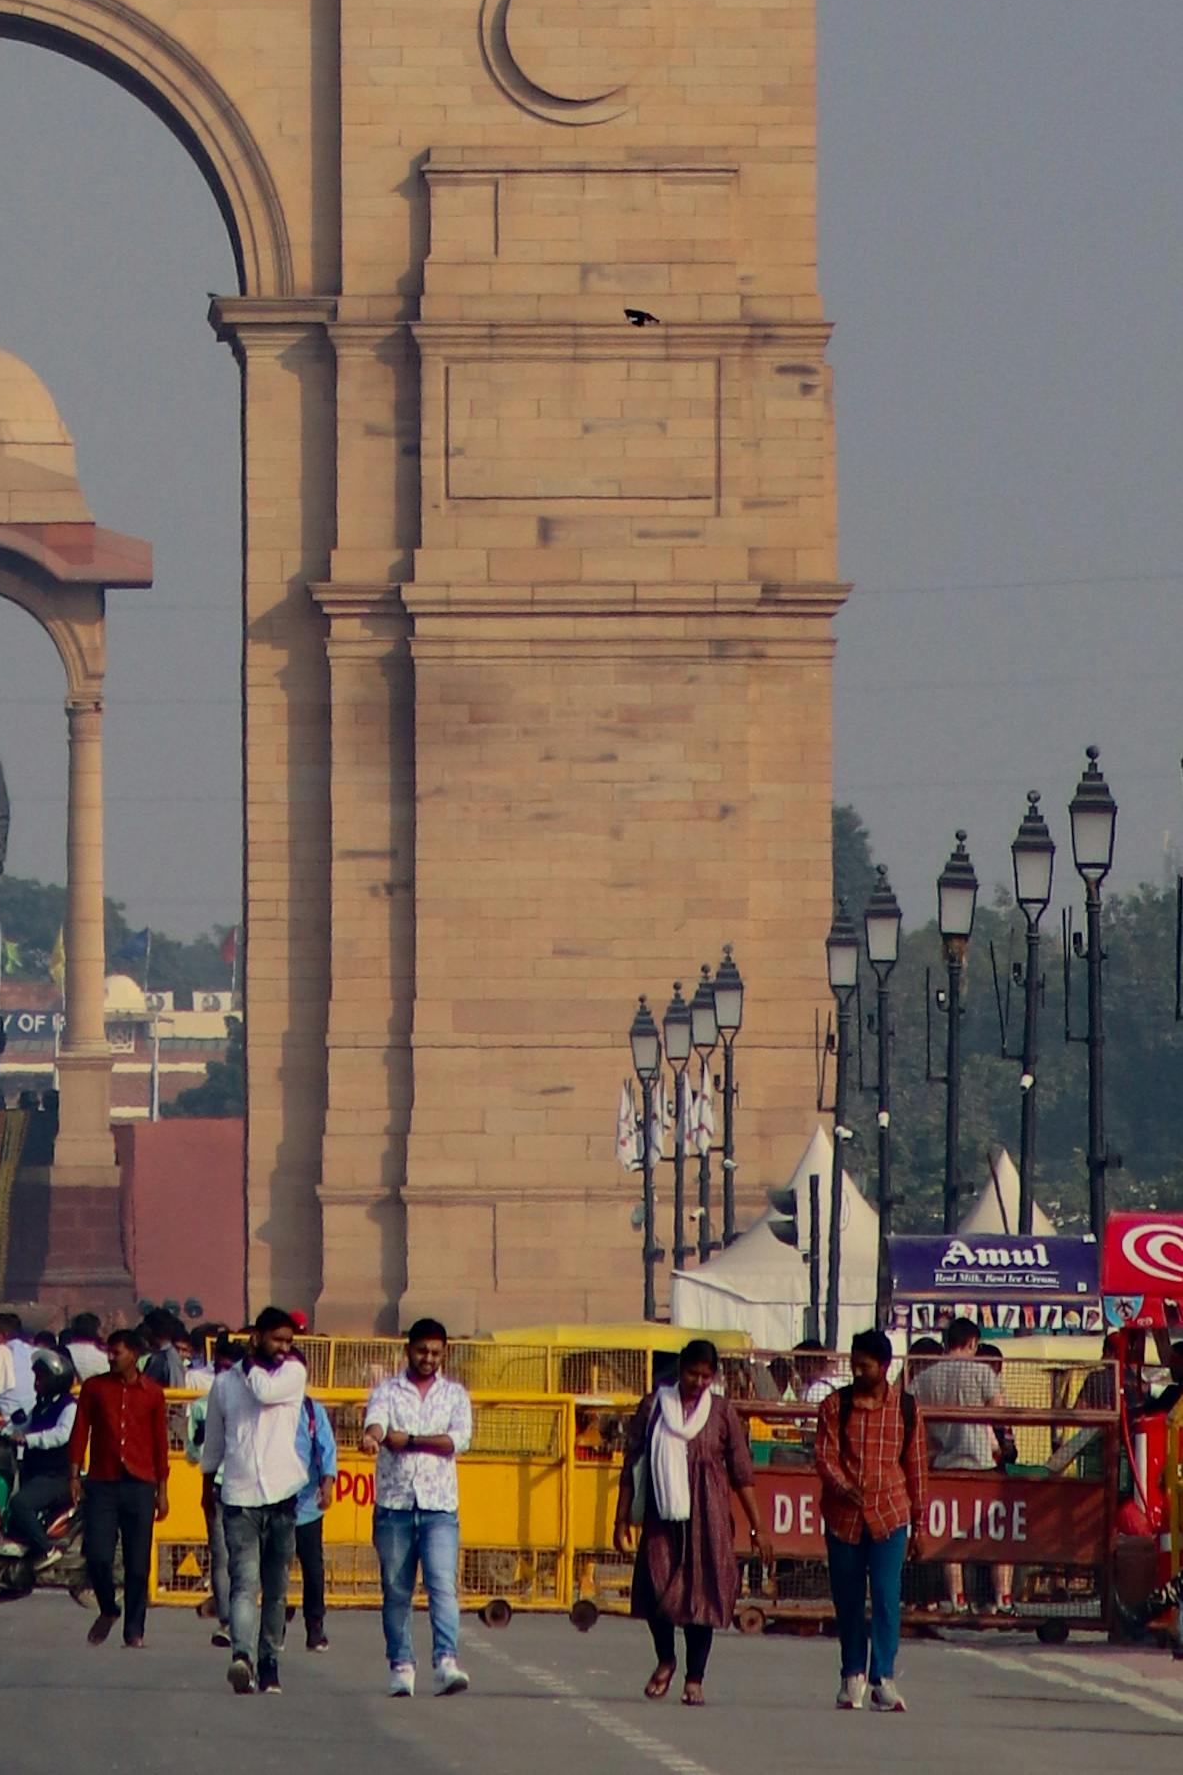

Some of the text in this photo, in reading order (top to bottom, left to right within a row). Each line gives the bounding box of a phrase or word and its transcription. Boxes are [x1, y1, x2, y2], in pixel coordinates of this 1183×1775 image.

[17, 1012, 47, 1033] OF
[940, 1240, 1051, 1268] Amul
[927, 1498, 1028, 1542] OLICE
